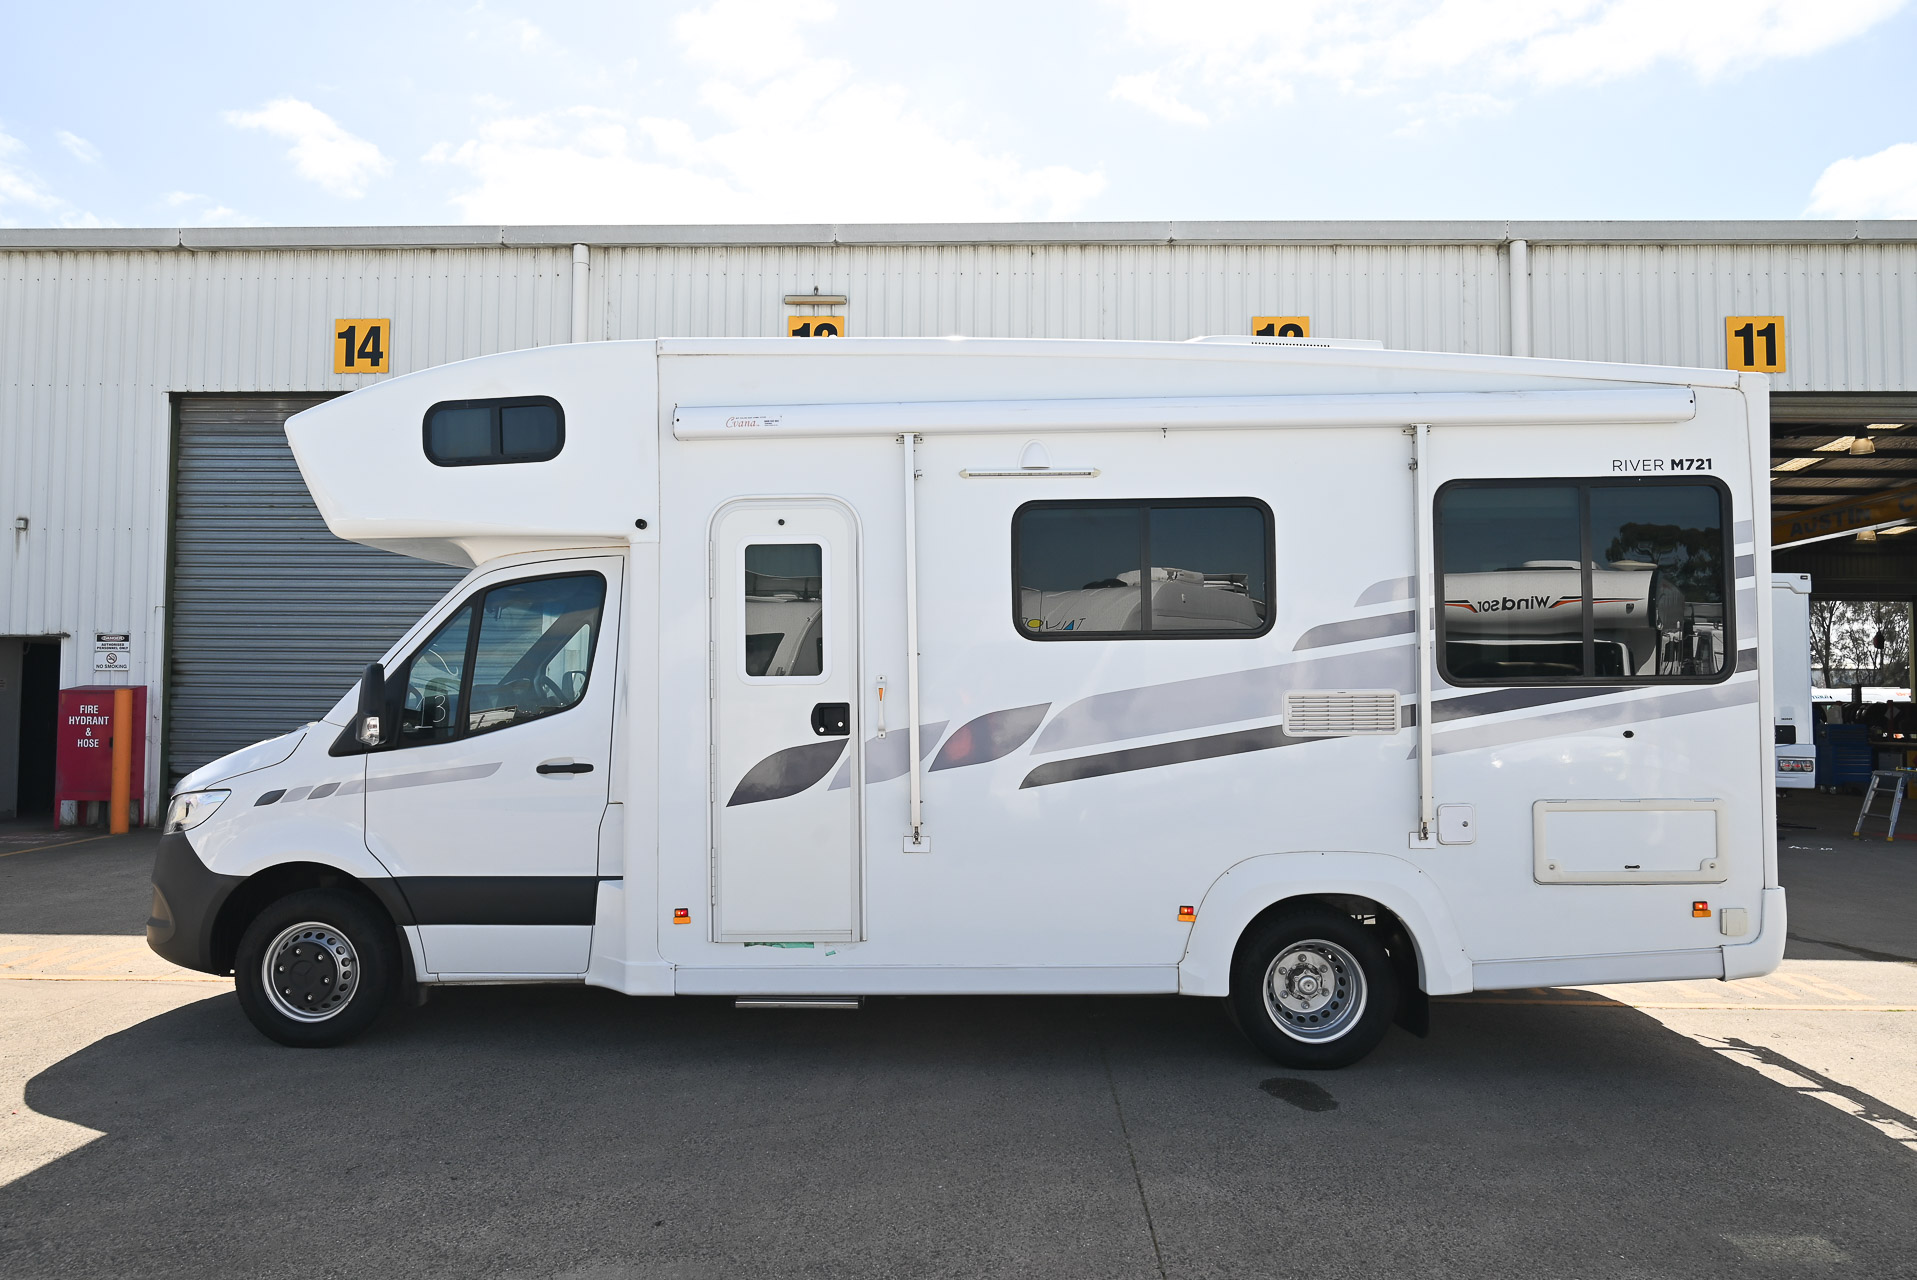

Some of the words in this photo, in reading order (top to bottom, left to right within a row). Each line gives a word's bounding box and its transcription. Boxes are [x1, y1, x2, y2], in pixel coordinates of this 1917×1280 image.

[337, 325, 384, 367] 14
[1734, 322, 1777, 366] 11
[1612, 459, 1665, 472] RIVER
[1670, 458, 1712, 471] M721
[1789, 506, 1871, 538] AUSTIN
[80, 705, 99, 714] FIRE
[69, 716, 109, 725] HYDRANT
[85, 727, 92, 737] &
[77, 739, 100, 748] HOSE
